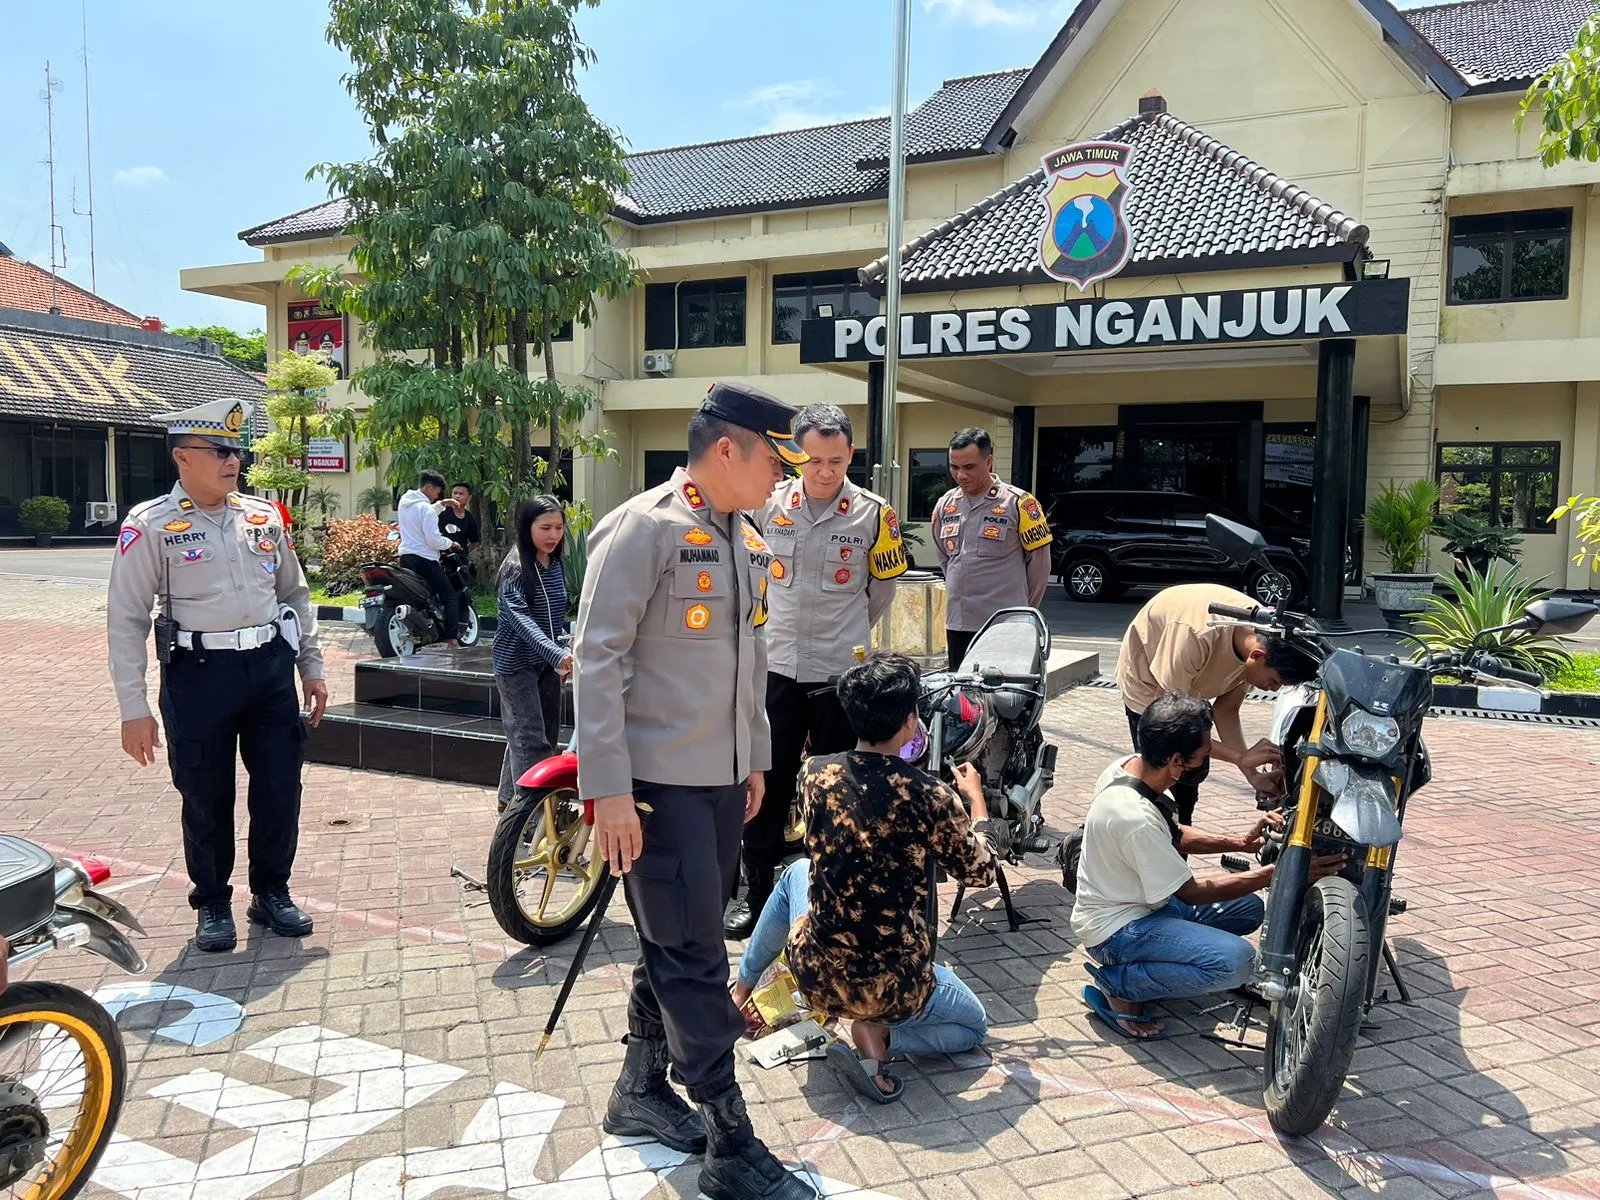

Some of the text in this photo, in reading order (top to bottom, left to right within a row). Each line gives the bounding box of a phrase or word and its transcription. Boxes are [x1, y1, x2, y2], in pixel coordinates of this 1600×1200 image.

[1054, 149, 1119, 168] JAWA TIMUR
[834, 286, 1352, 359] POLRES NGANJUK
[984, 516, 1008, 525] POLRI
[164, 532, 206, 546] HERRY
[247, 527, 277, 540] POLRI
[831, 534, 864, 546] POLRI
[680, 548, 719, 563] MUHAMMAD
